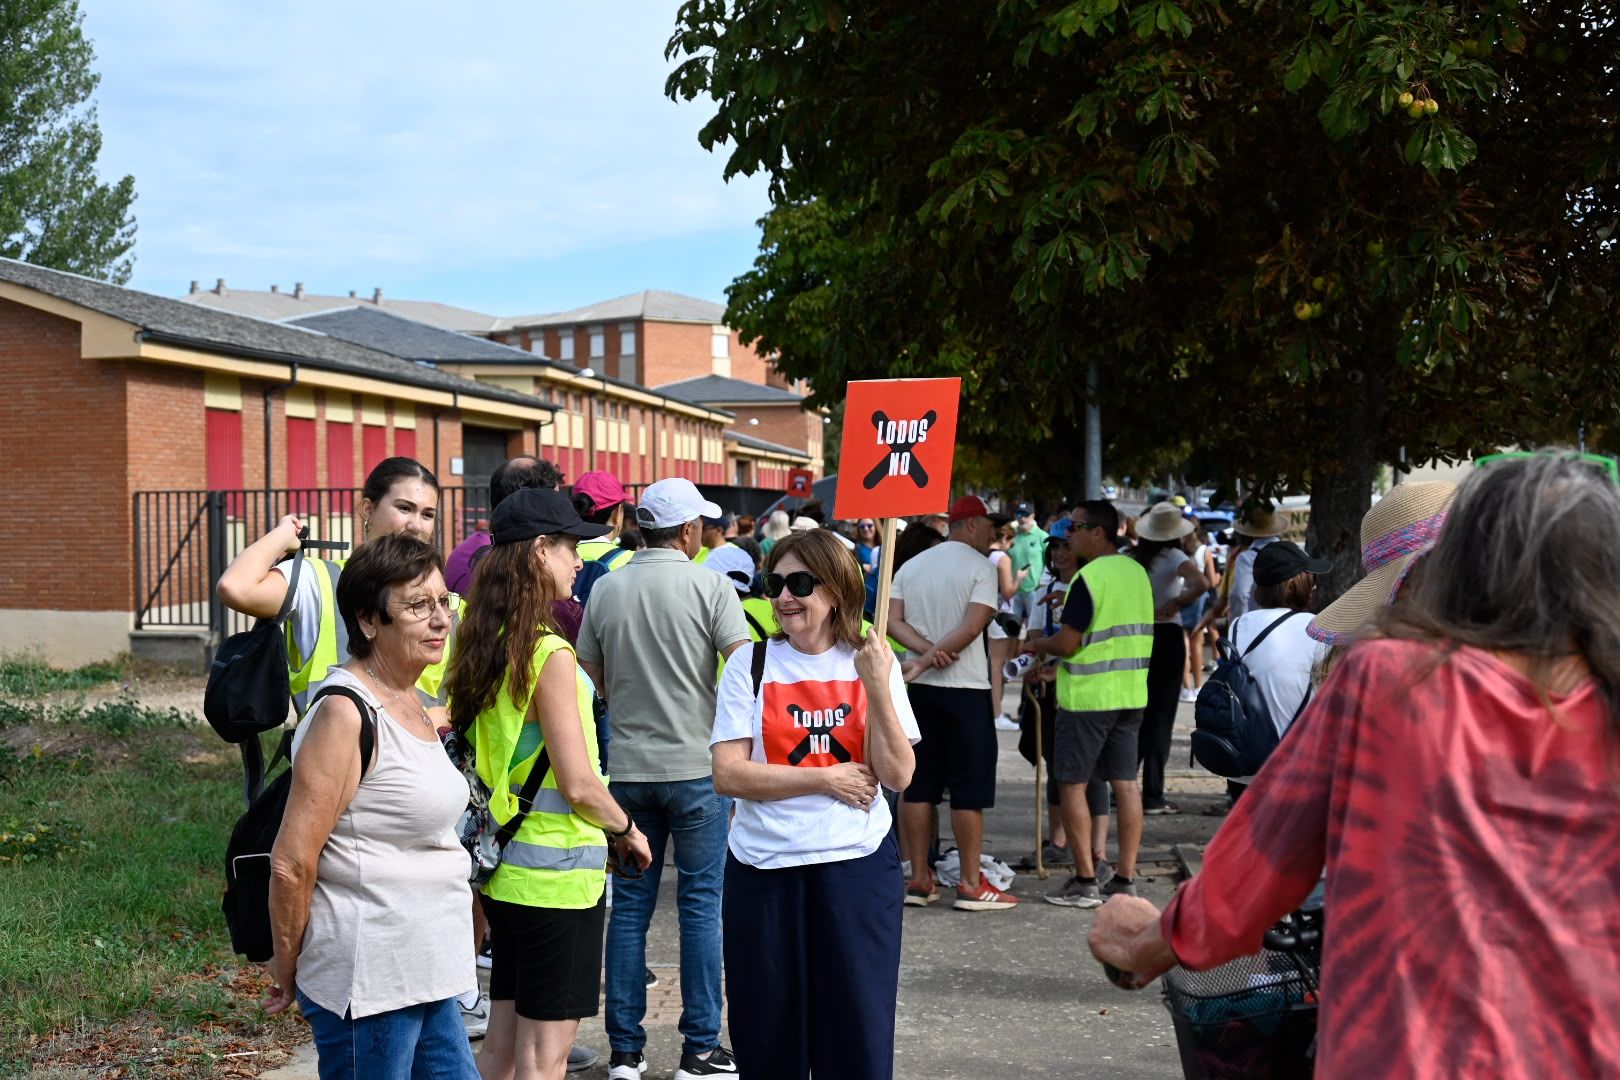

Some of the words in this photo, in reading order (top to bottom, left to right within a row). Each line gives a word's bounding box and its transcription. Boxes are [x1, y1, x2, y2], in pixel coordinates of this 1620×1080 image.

[877, 418, 929, 445] LODOS
[888, 452, 911, 477] NO
[794, 708, 845, 728] LODOS
[809, 734, 831, 754] NO
